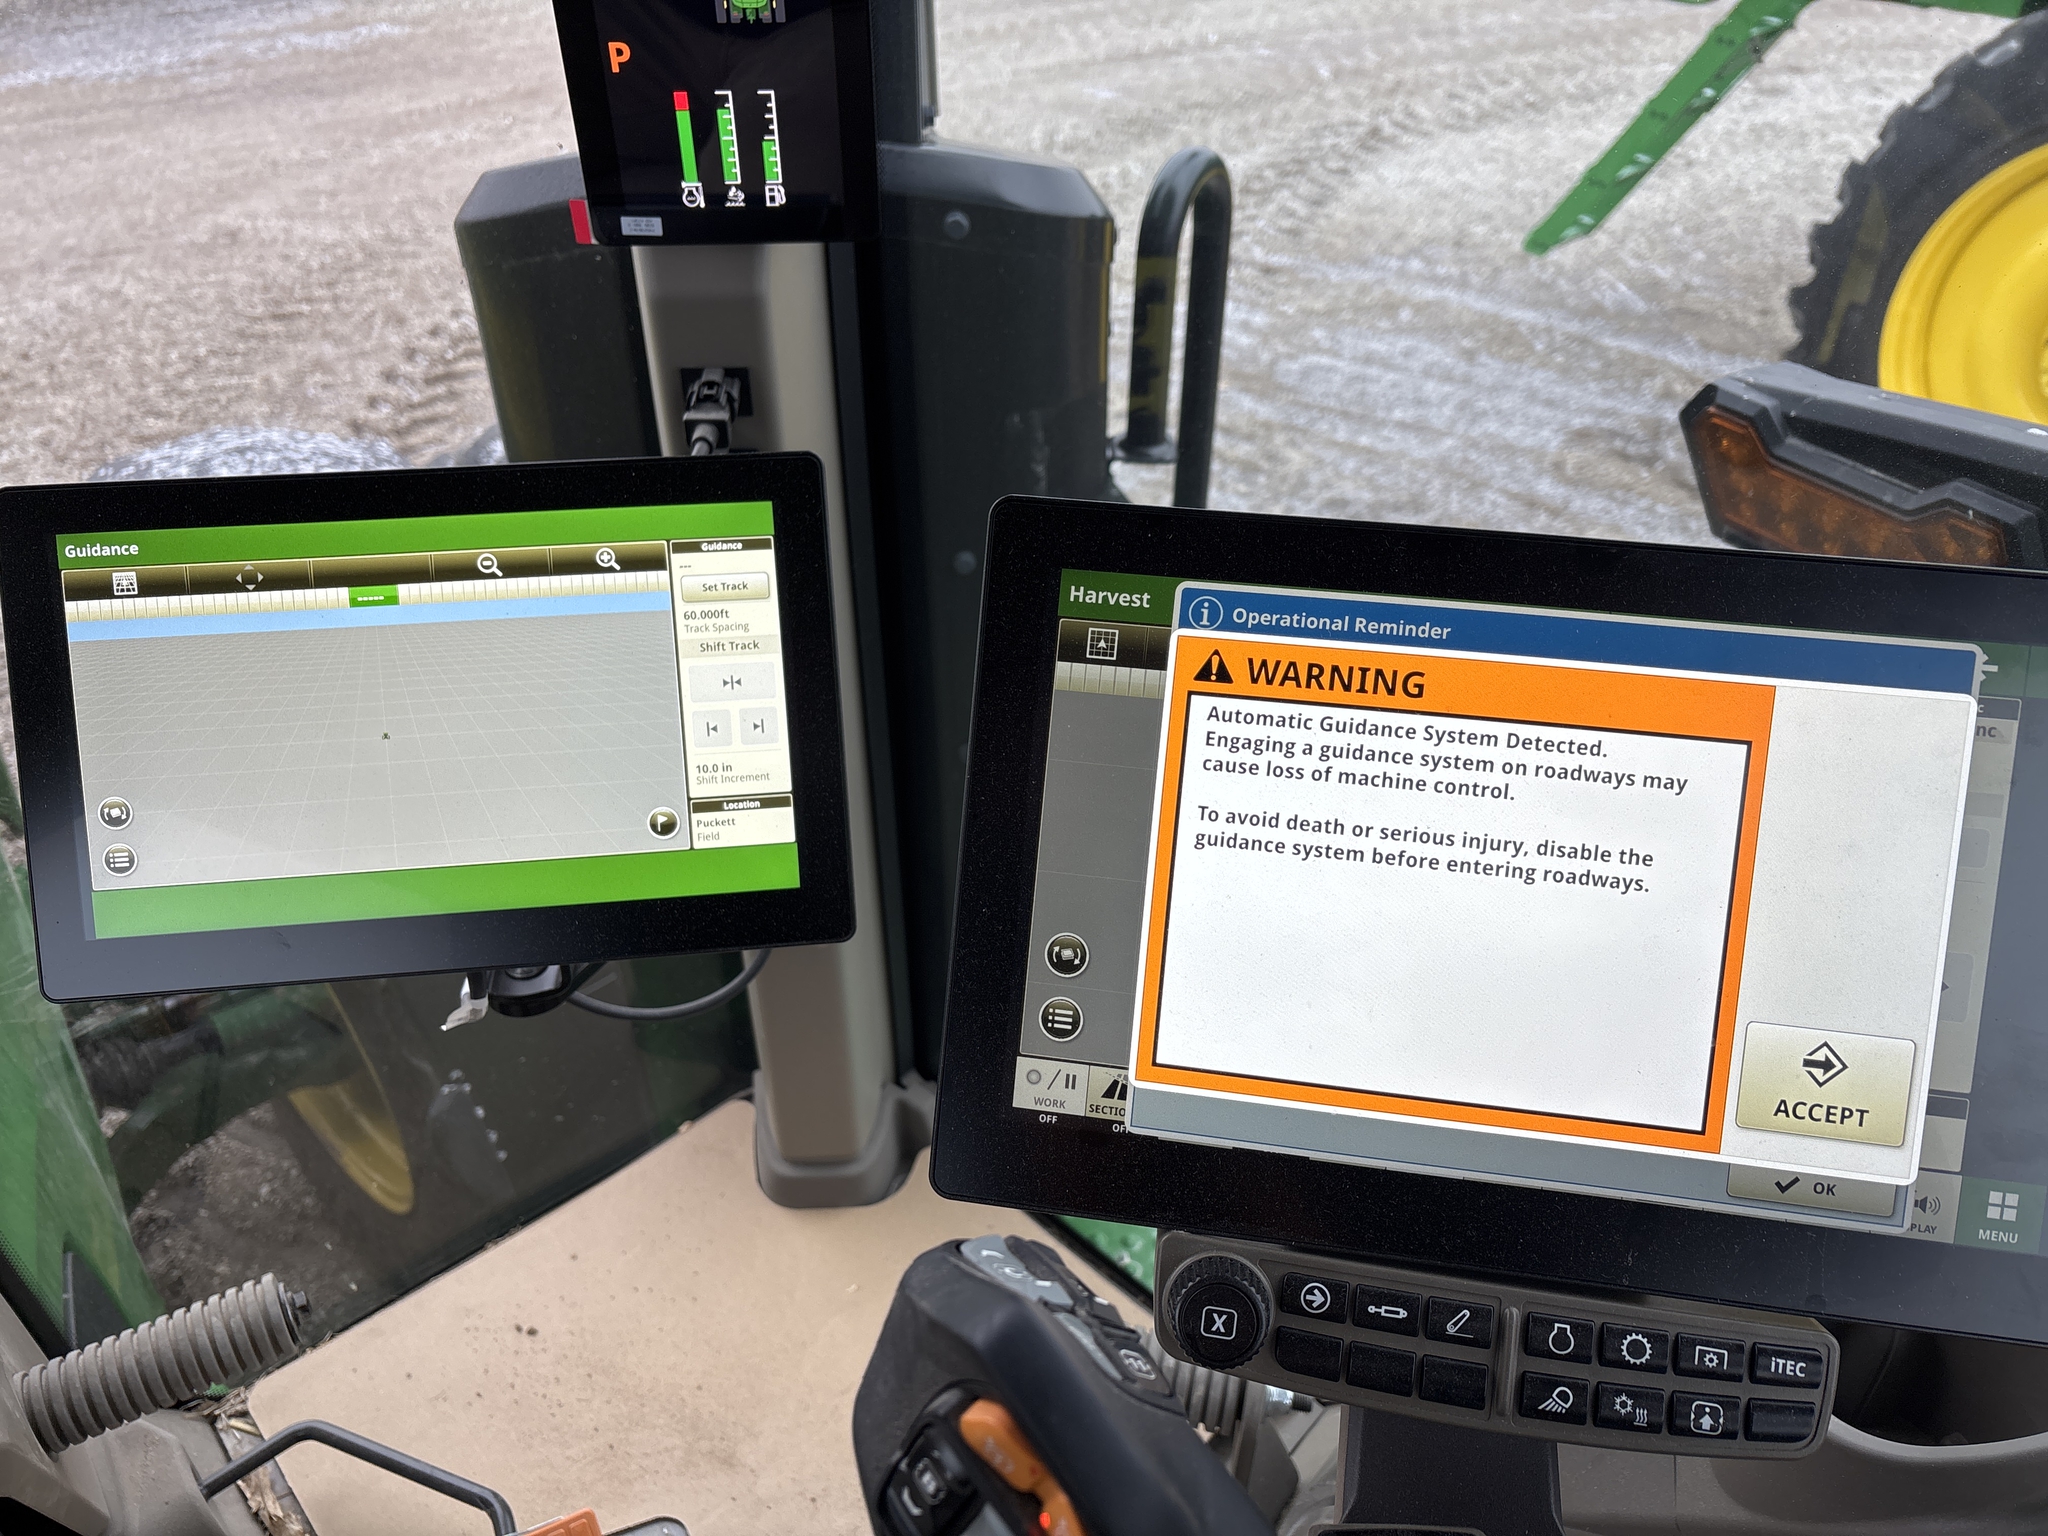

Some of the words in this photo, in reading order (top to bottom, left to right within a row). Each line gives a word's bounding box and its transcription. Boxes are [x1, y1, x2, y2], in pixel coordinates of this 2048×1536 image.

[608, 42, 631, 73] P
[64, 543, 139, 558] Guidance
[701, 540, 743, 551] Guidance
[702, 582, 719, 592] Set
[720, 581, 749, 591] Track
[1069, 585, 1151, 608] Harvest
[683, 608, 730, 621] 60.000ft
[684, 623, 712, 633] Track
[713, 620, 750, 634] Spacing
[1232, 607, 1350, 632] Operational
[1354, 617, 1452, 640] Reminder
[699, 641, 727, 652] Shift
[729, 640, 760, 651] Track
[1247, 657, 1425, 699] WARNING
[1206, 706, 1314, 731] Automatic
[1319, 716, 1417, 740] Guidance
[1423, 724, 1499, 747] System
[1506, 732, 1608, 759] Detected.
[695, 763, 719, 774] 10.0
[722, 761, 733, 772] in
[1205, 731, 1296, 758] Engaging
[1302, 740, 1313, 755] a
[1318, 742, 1415, 766] guidance
[1419, 752, 1495, 773] system
[1501, 762, 1528, 776] on
[1534, 763, 1636, 790] roadways
[1642, 775, 1689, 796] may
[696, 775, 717, 785] Shift
[719, 771, 770, 783] Increment
[1202, 758, 1260, 776] cause
[1266, 760, 1305, 779] loss
[1310, 766, 1333, 783] of
[1337, 770, 1427, 792] machine
[1433, 780, 1515, 801] control.
[723, 799, 761, 811] Location
[696, 816, 736, 828] Puckett
[697, 830, 720, 842] Field
[1197, 805, 1220, 823] To
[1225, 811, 1280, 829] avoid
[1286, 814, 1345, 836] death
[1351, 824, 1374, 838] or
[1379, 826, 1456, 847] serious
[1461, 831, 1529, 857] injury,
[1536, 840, 1612, 863] disable
[1618, 848, 1654, 867] the
[1194, 832, 1286, 854] guidance
[1291, 842, 1365, 863] system
[1371, 847, 1440, 870] before
[1446, 857, 1537, 885] entering
[1543, 868, 1650, 895] roadways.
[1033, 1096, 1066, 1109] WORK
[1039, 1114, 1058, 1124] OFF
[1773, 1099, 1870, 1128] ACCEPT
[1813, 1182, 1837, 1196] OK
[1908, 1223, 1938, 1235] PLAY
[1978, 1228, 2018, 1244] MENU
[1771, 1356, 1806, 1378] iTEC
